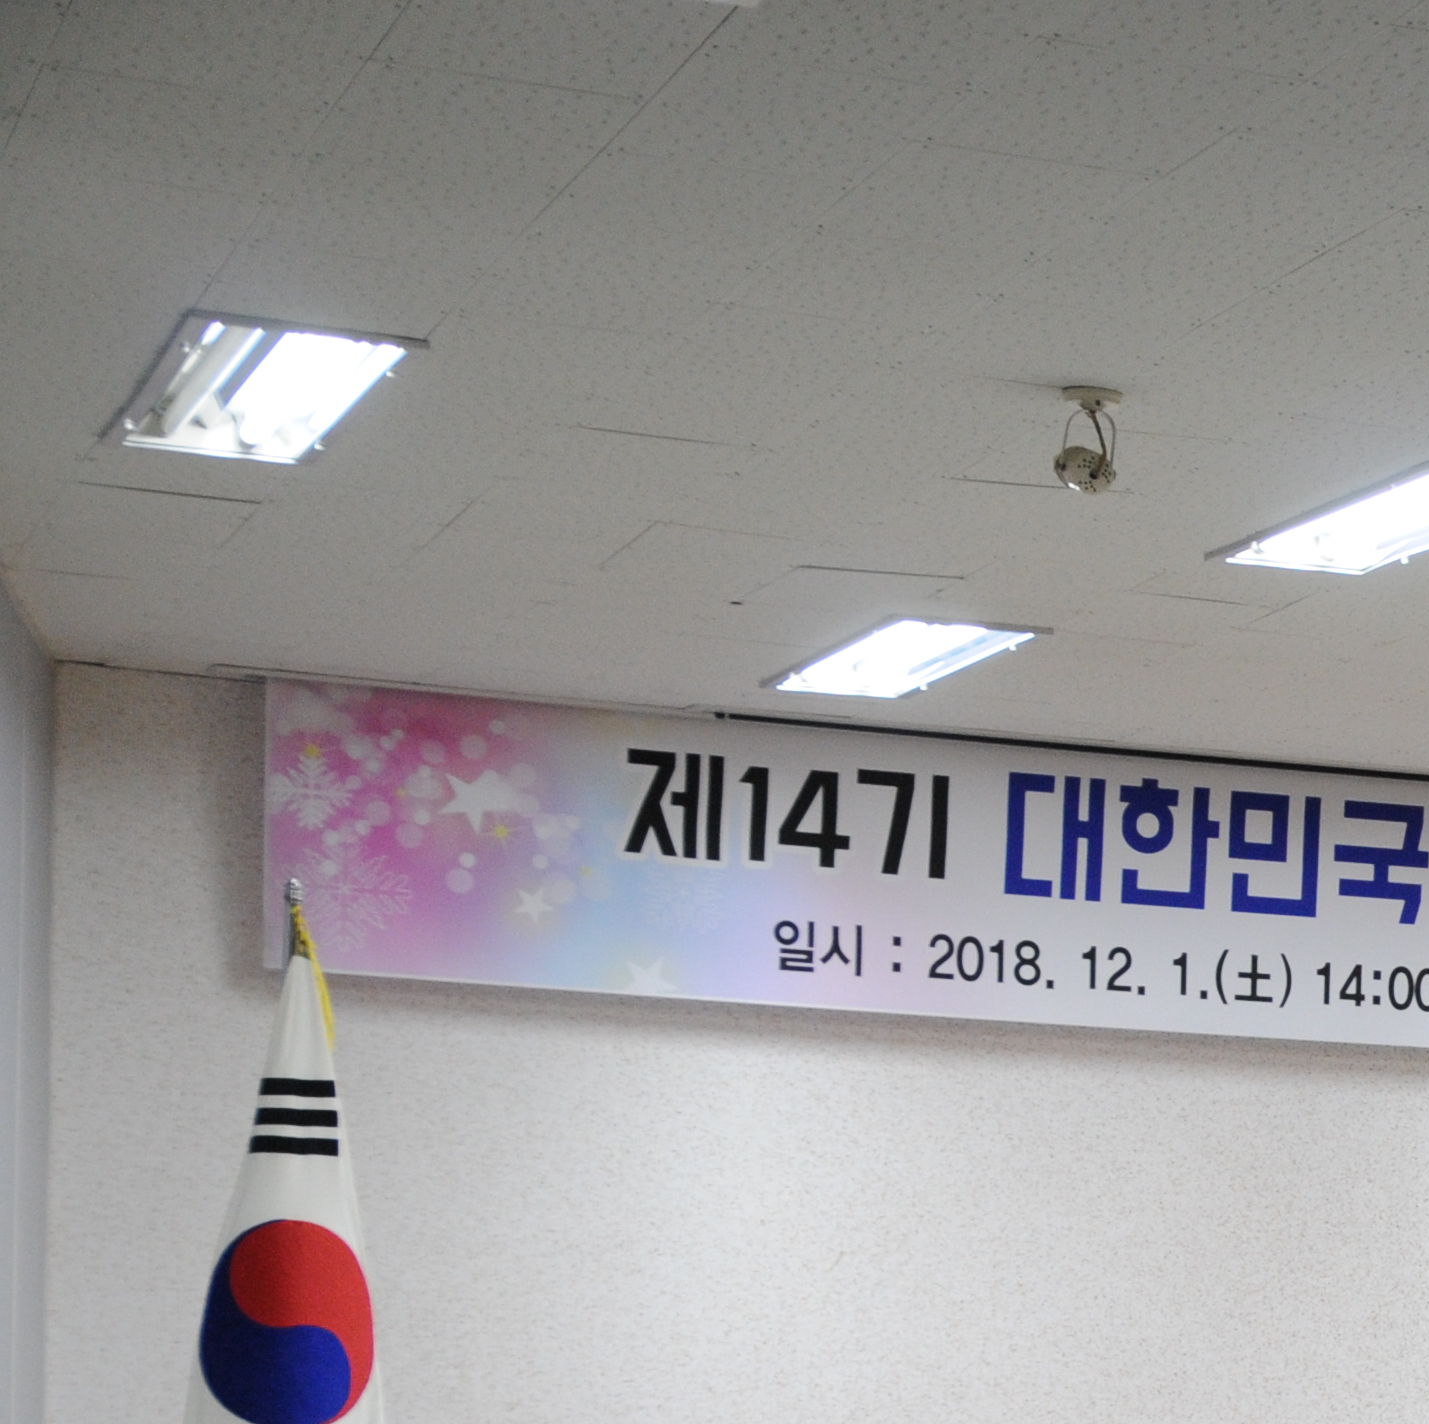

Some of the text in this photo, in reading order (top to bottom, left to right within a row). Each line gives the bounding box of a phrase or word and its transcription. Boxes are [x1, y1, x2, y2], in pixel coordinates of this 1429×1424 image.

[623, 745, 952, 880] 제14기
[773, 920, 863, 977] 일시
[928, 932, 1055, 989] 2018.
[1082, 945, 1147, 996] 12.
